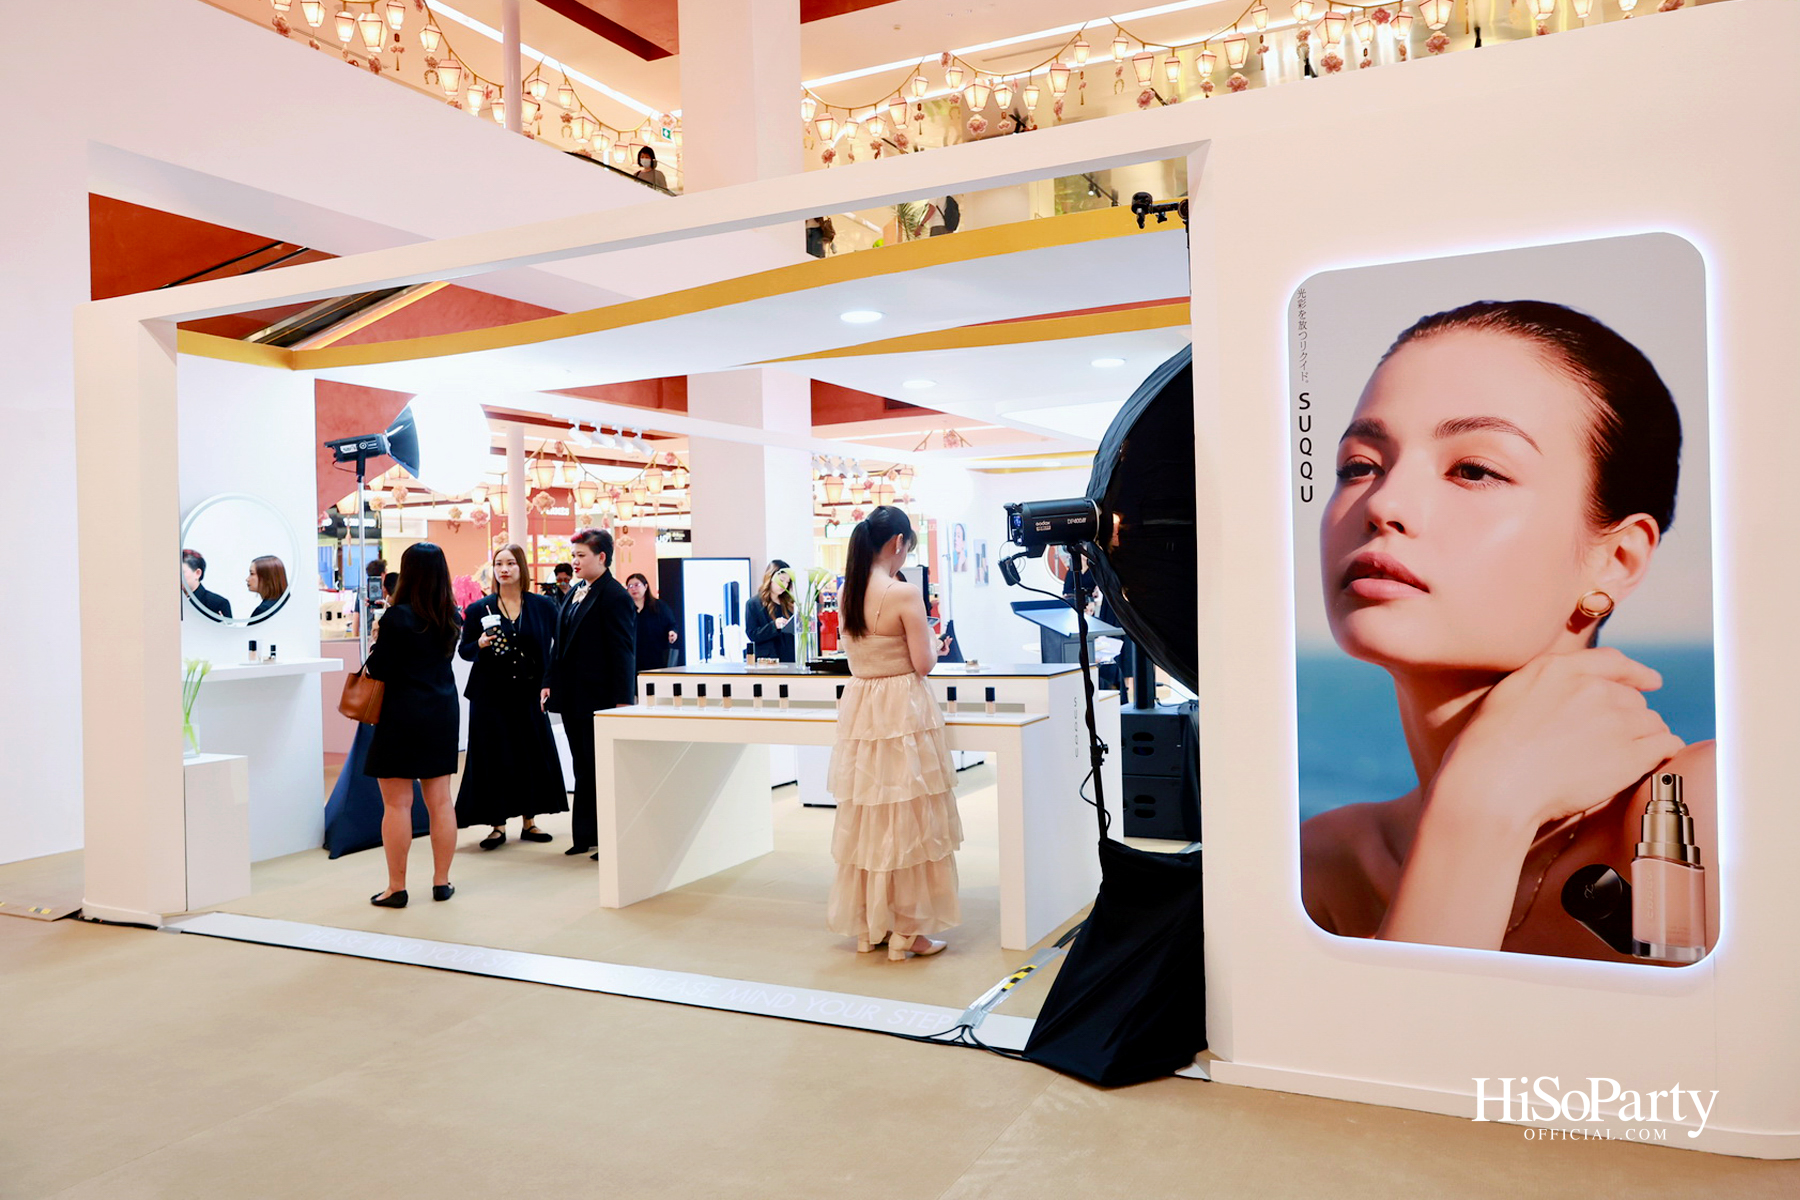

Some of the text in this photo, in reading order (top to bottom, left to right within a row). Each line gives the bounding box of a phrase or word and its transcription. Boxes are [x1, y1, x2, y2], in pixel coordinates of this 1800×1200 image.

[1297, 288, 1309, 384] 光彩を放つリクイド。
[1298, 392, 1313, 503] SUQQU
[425, 945, 485, 965] YOUR
[635, 974, 954, 1031] PLEASE MIND YOUR STEP
